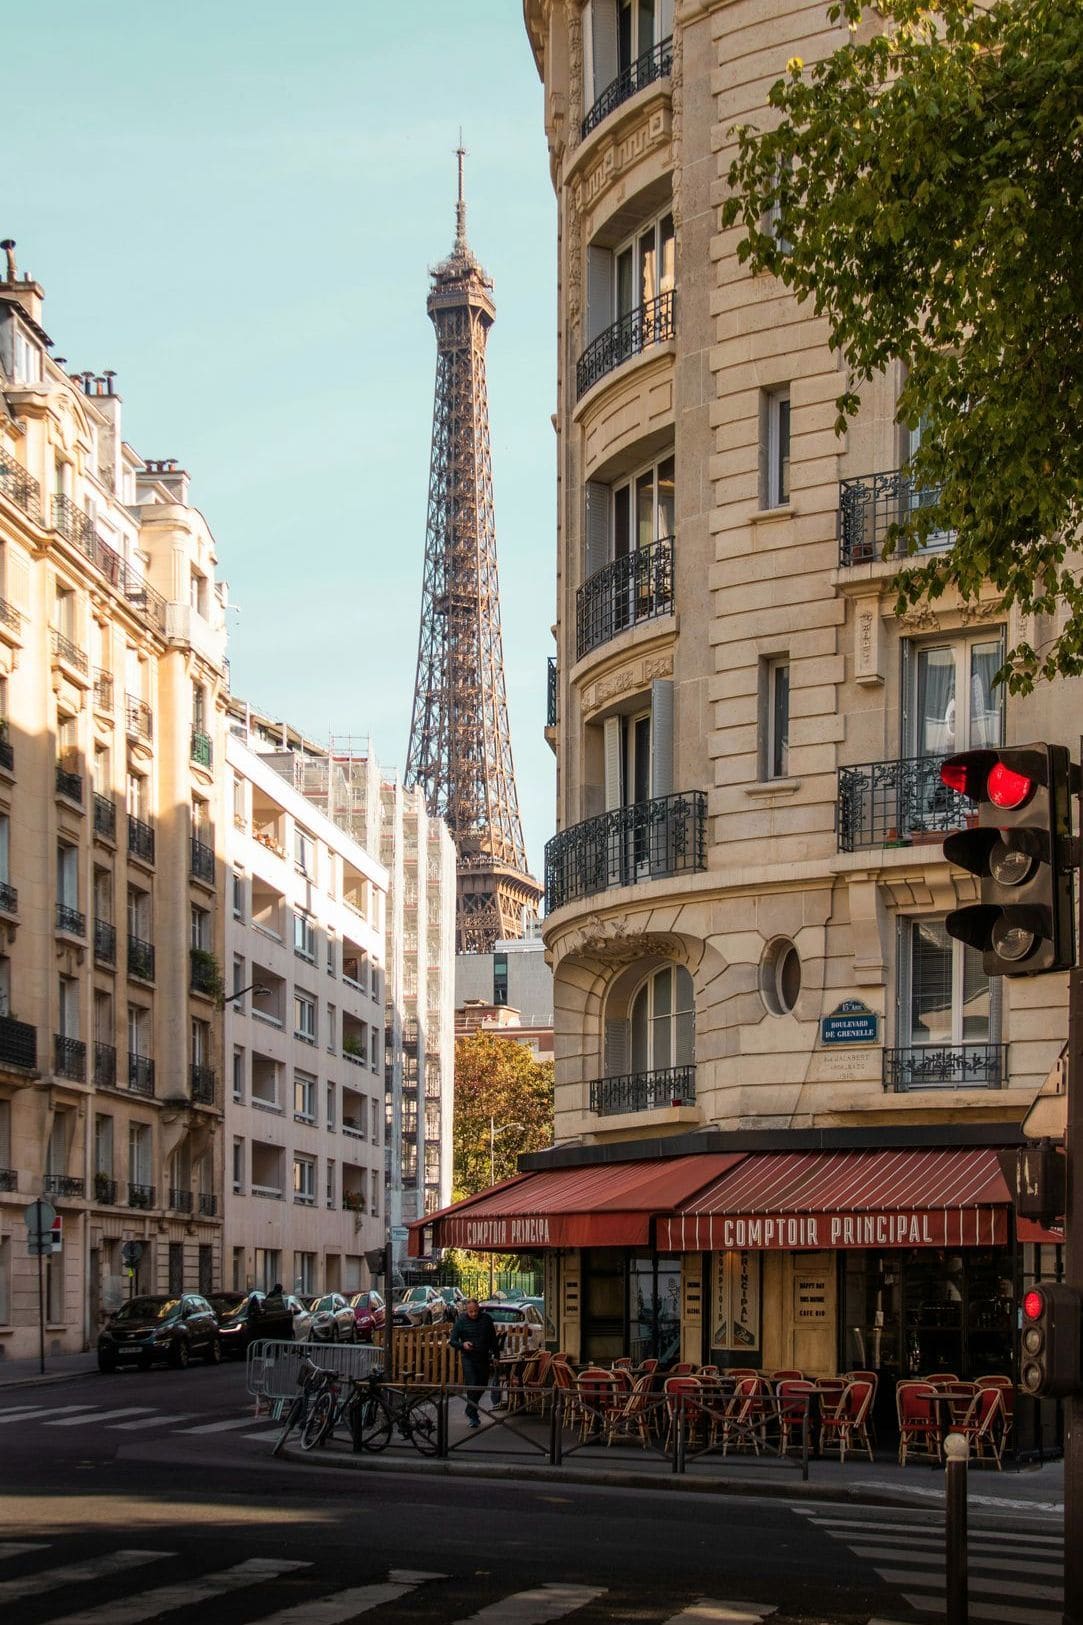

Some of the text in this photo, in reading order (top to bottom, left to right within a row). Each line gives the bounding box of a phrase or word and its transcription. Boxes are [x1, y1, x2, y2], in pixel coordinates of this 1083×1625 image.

[837, 1030, 874, 1038] GRENELLE
[467, 1218, 550, 1245] COMPTOIR PRINCIPA
[723, 1214, 933, 1247] COMPTOIR PRINCIPAL
